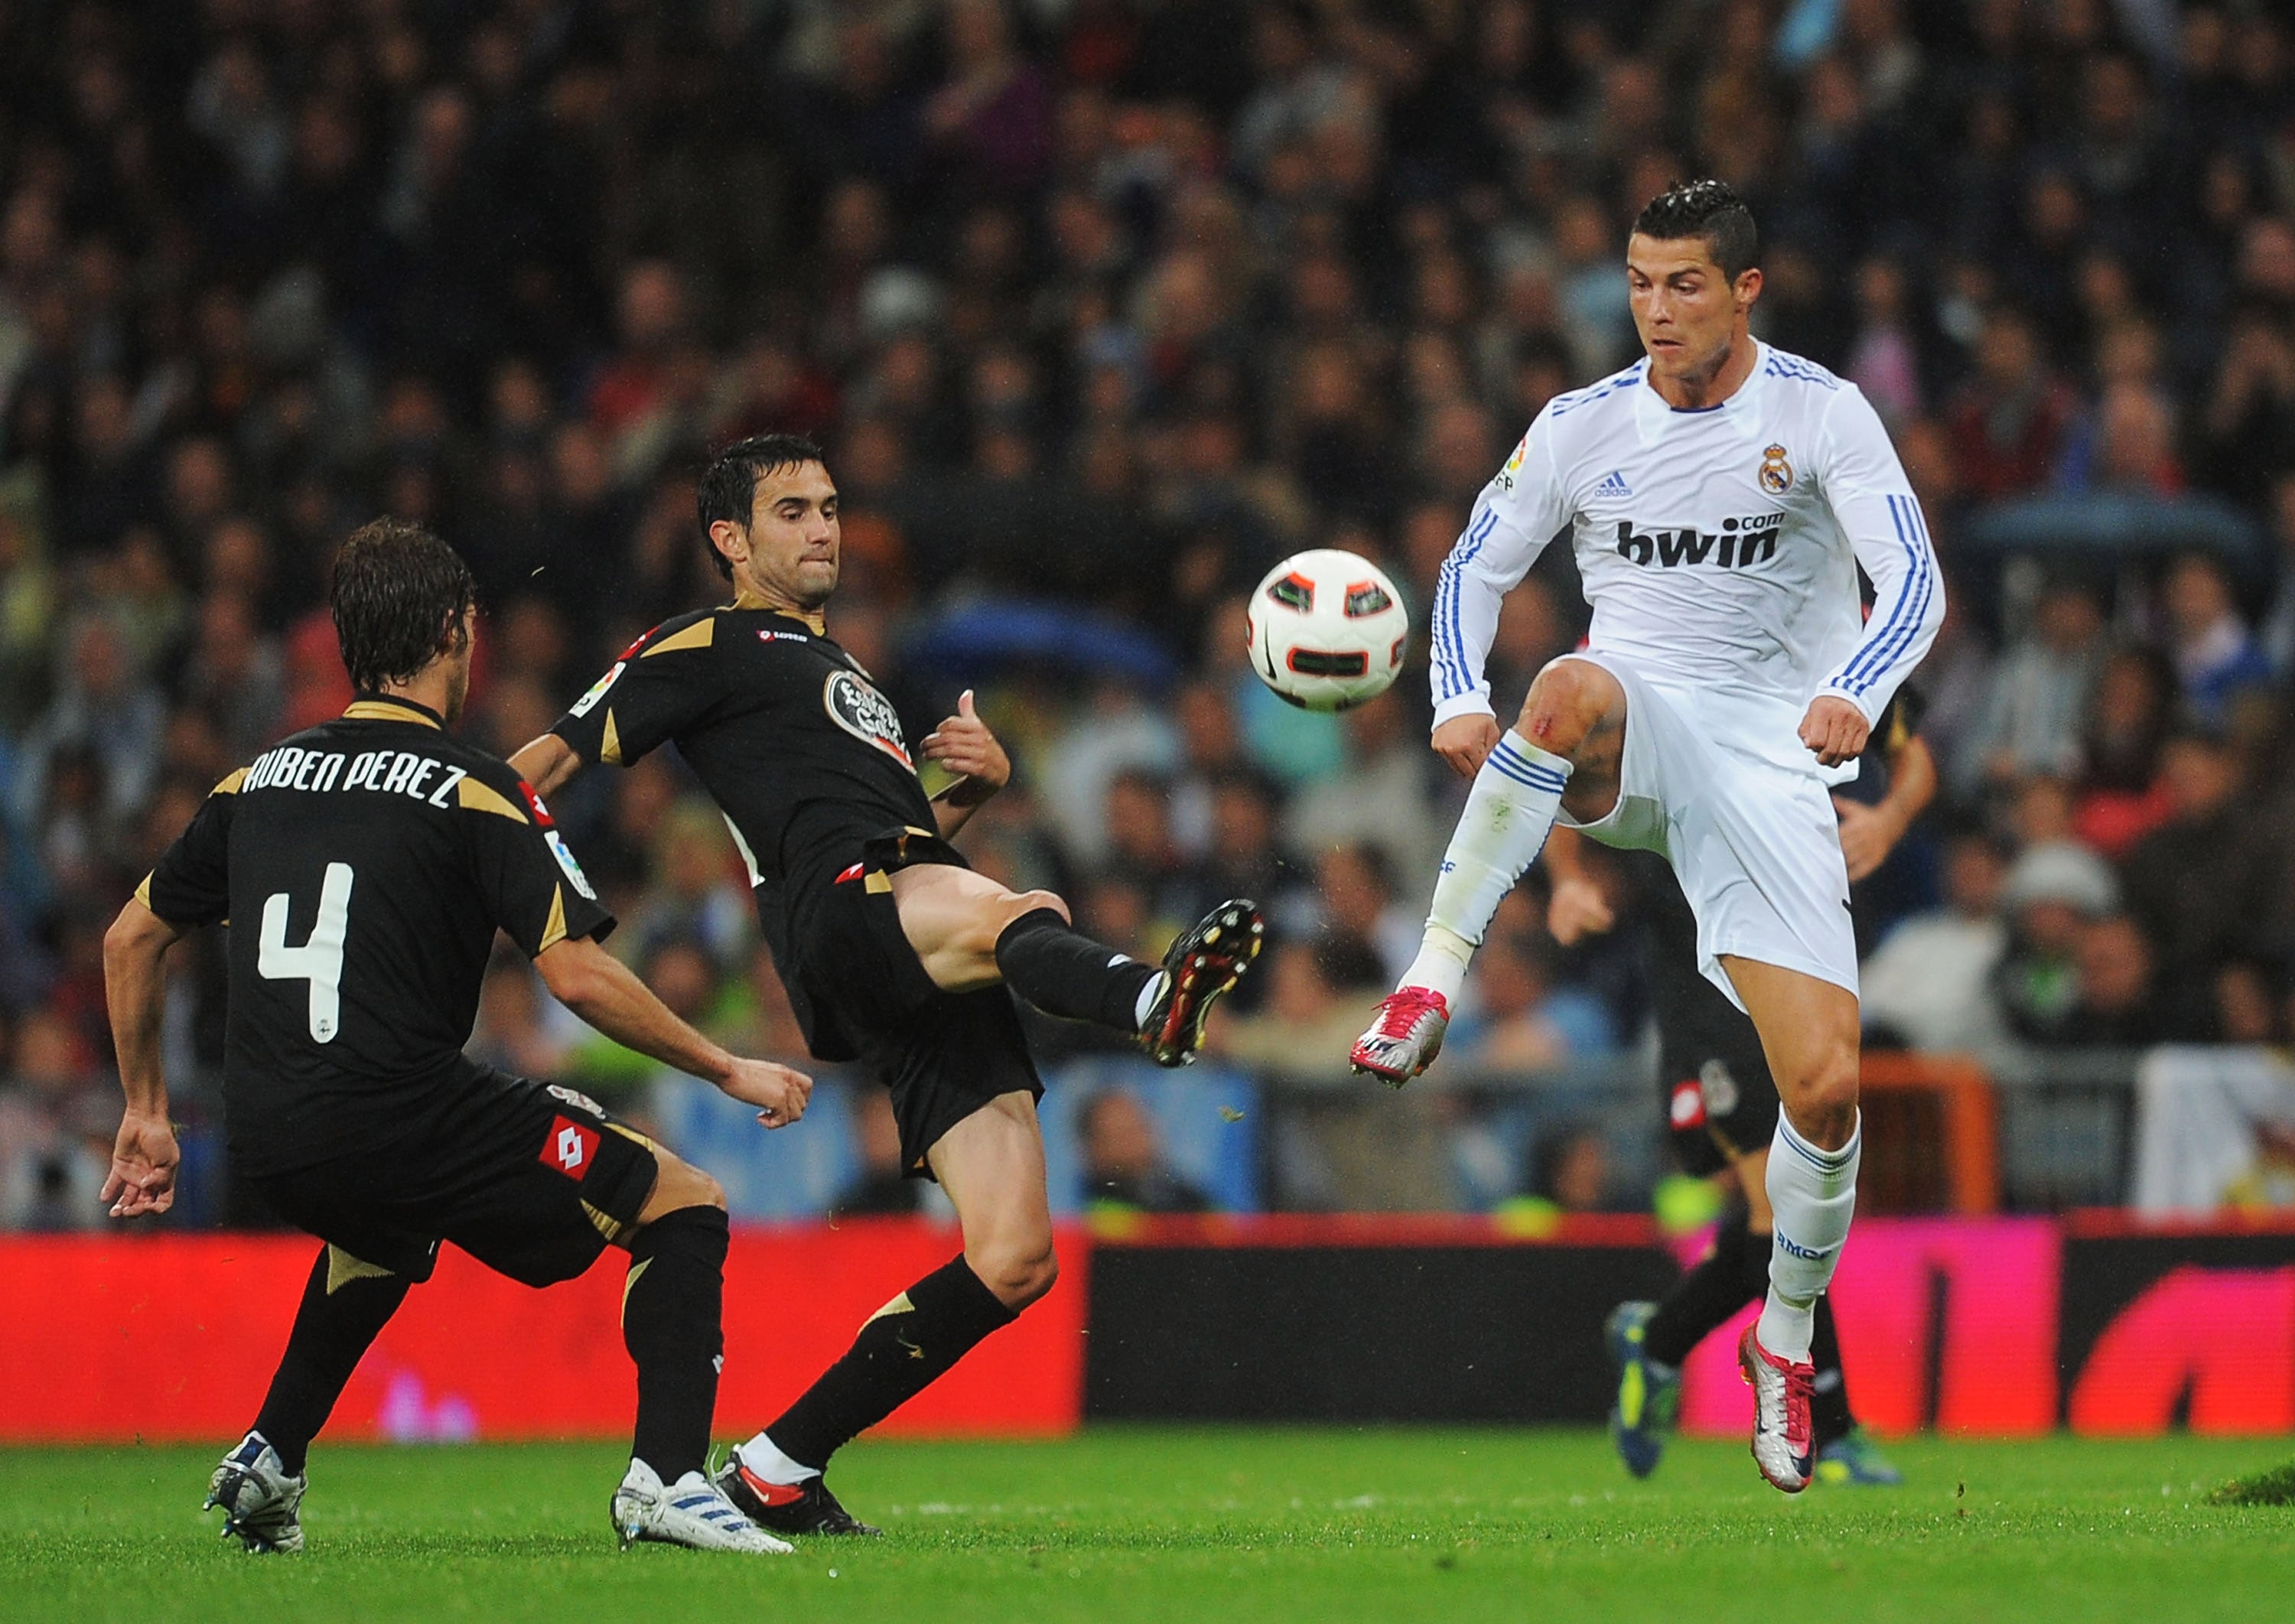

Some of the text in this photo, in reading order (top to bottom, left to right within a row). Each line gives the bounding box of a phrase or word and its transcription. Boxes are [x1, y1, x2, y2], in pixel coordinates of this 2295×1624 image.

[1594, 488, 1633, 497] adidas
[1617, 517, 1779, 568] bwin
[242, 747, 467, 809] RUBEN PEREZ
[258, 862, 354, 1043] 4
